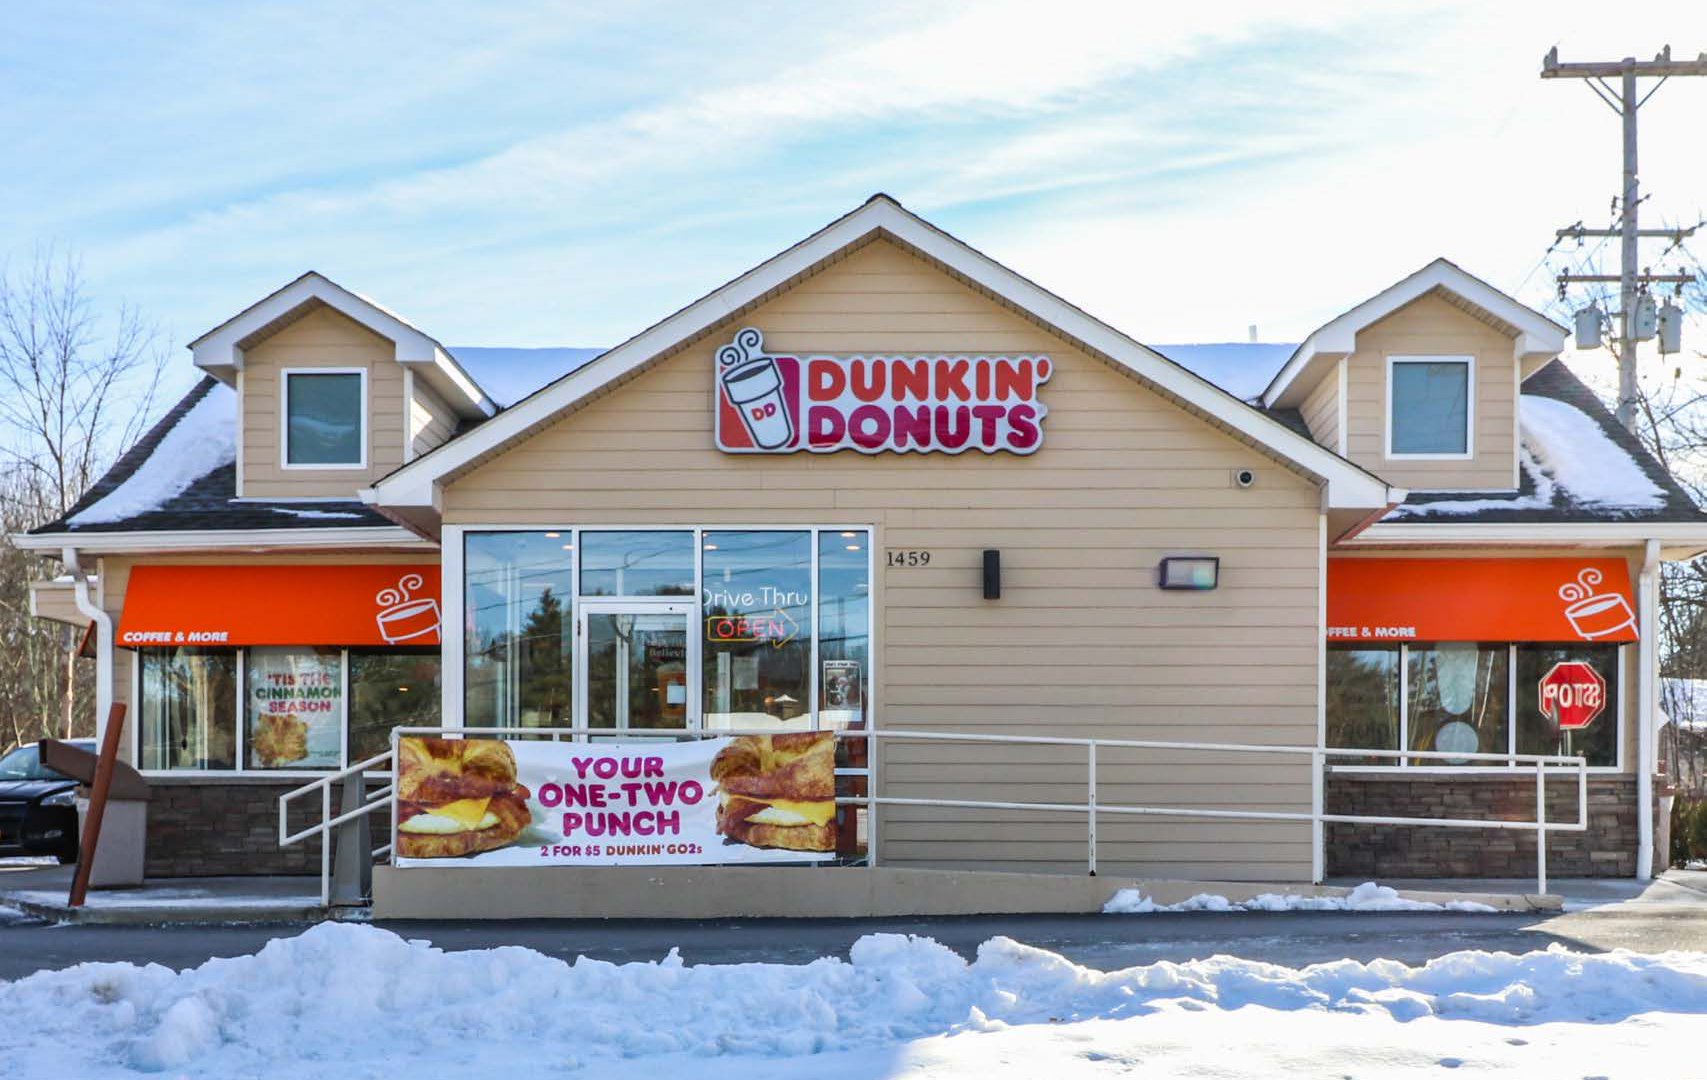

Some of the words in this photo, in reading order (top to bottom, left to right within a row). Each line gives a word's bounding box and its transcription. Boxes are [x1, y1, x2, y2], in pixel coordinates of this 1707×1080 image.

[808, 359, 1049, 401] DUNKIN'
[751, 403, 776, 421] DD
[808, 404, 1038, 448] DONUTS
[887, 551, 930, 566] 1459
[123, 631, 172, 642] COFFEE
[175, 631, 185, 642] &
[188, 631, 228, 642] MORE
[716, 620, 784, 638] OPEN
[1327, 627, 1358, 637] FFEE
[1361, 627, 1371, 637] &
[1375, 627, 1416, 637] MORE
[300, 672, 331, 685] THE
[255, 686, 341, 699] CINNAMON
[268, 701, 331, 713] SEASON
[571, 756, 664, 780] YOUR
[537, 780, 704, 808] ONE-TWO
[562, 810, 681, 837] PUNCH
[540, 846, 549, 857] 2
[553, 845, 581, 857] FOR
[585, 845, 601, 857] $5
[606, 844, 665, 856] DUNKIN'
